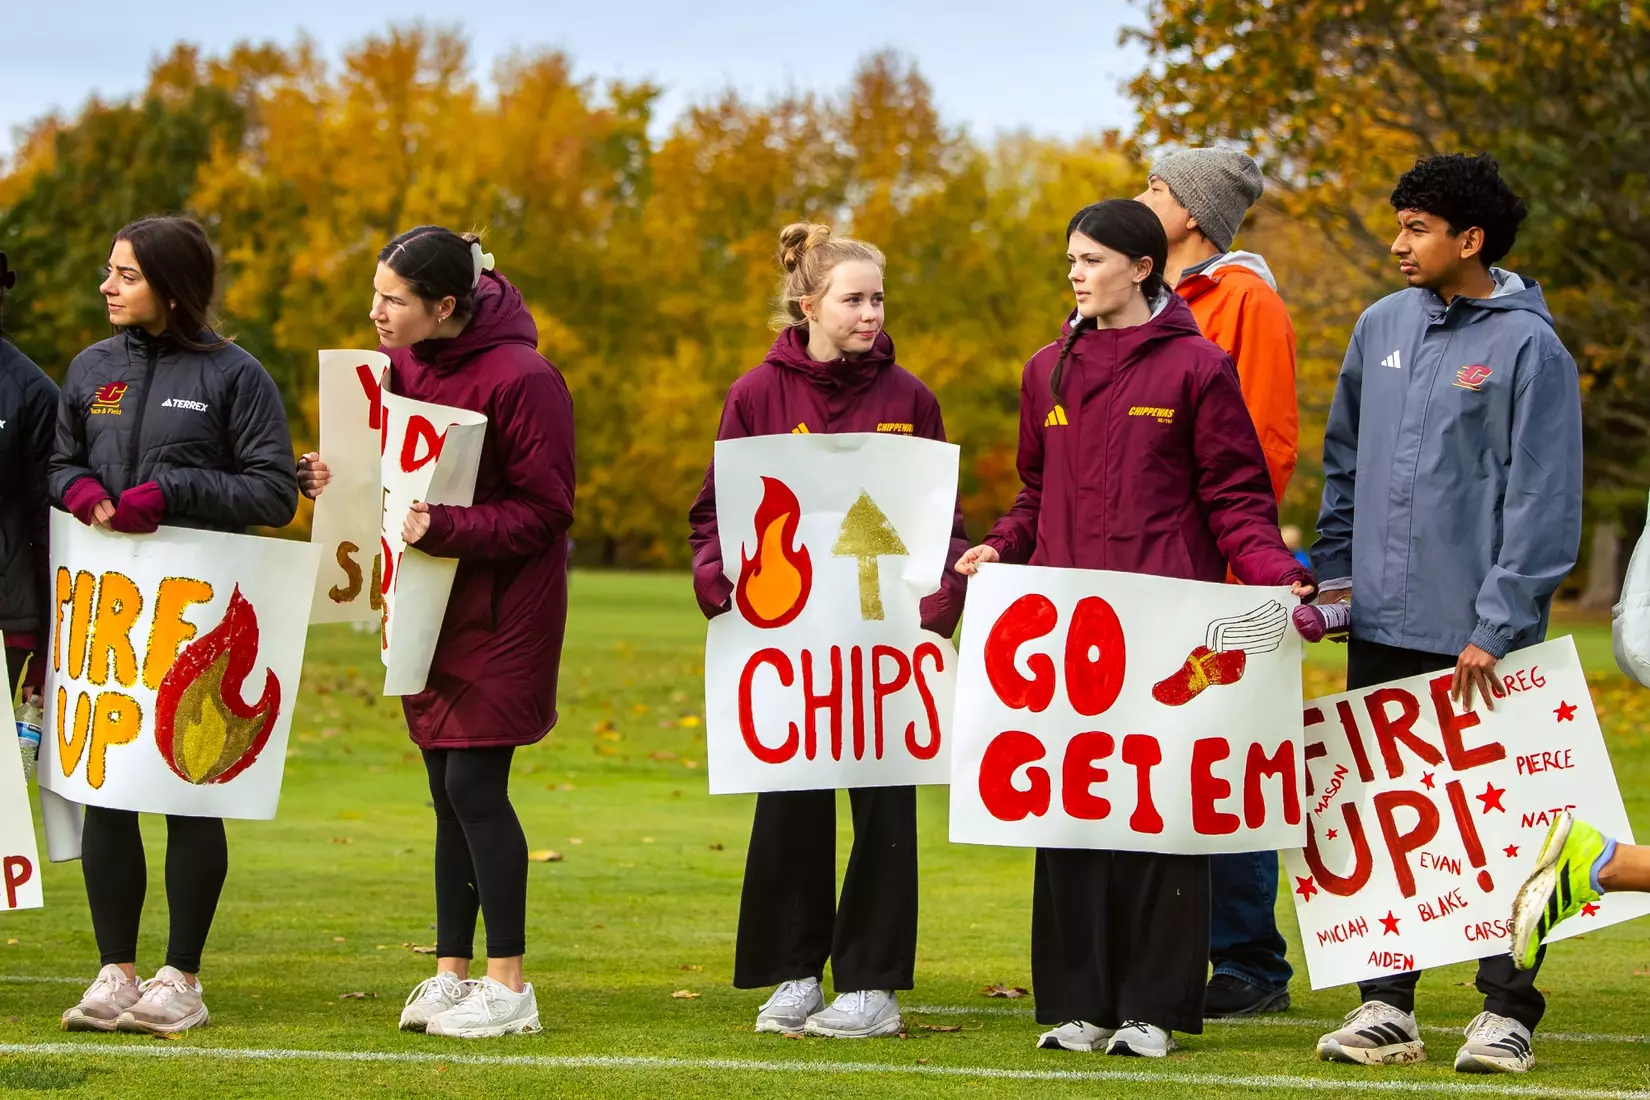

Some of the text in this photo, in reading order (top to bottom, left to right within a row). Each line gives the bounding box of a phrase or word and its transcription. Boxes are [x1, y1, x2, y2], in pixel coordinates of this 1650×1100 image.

[172, 399, 209, 412] TERREX
[1128, 406, 1175, 418] CHIPPEWAS
[54, 566, 214, 691] FIRE
[984, 593, 1126, 717] GO
[738, 642, 944, 764] CHIPS
[57, 685, 143, 790] UP
[1304, 673, 1507, 797] FIRE
[1516, 749, 1576, 776] PIERCE
[979, 730, 1301, 835] GET EM
[1314, 764, 1349, 818] MASON
[1521, 805, 1576, 828] NAT
[1302, 779, 1495, 899] UP!
[1420, 851, 1462, 876] EVAN
[1417, 887, 1469, 922] BLAKE
[1316, 915, 1369, 947] MICIAH
[1464, 918, 1514, 941] CARS
[1367, 950, 1415, 971] AIDEN
